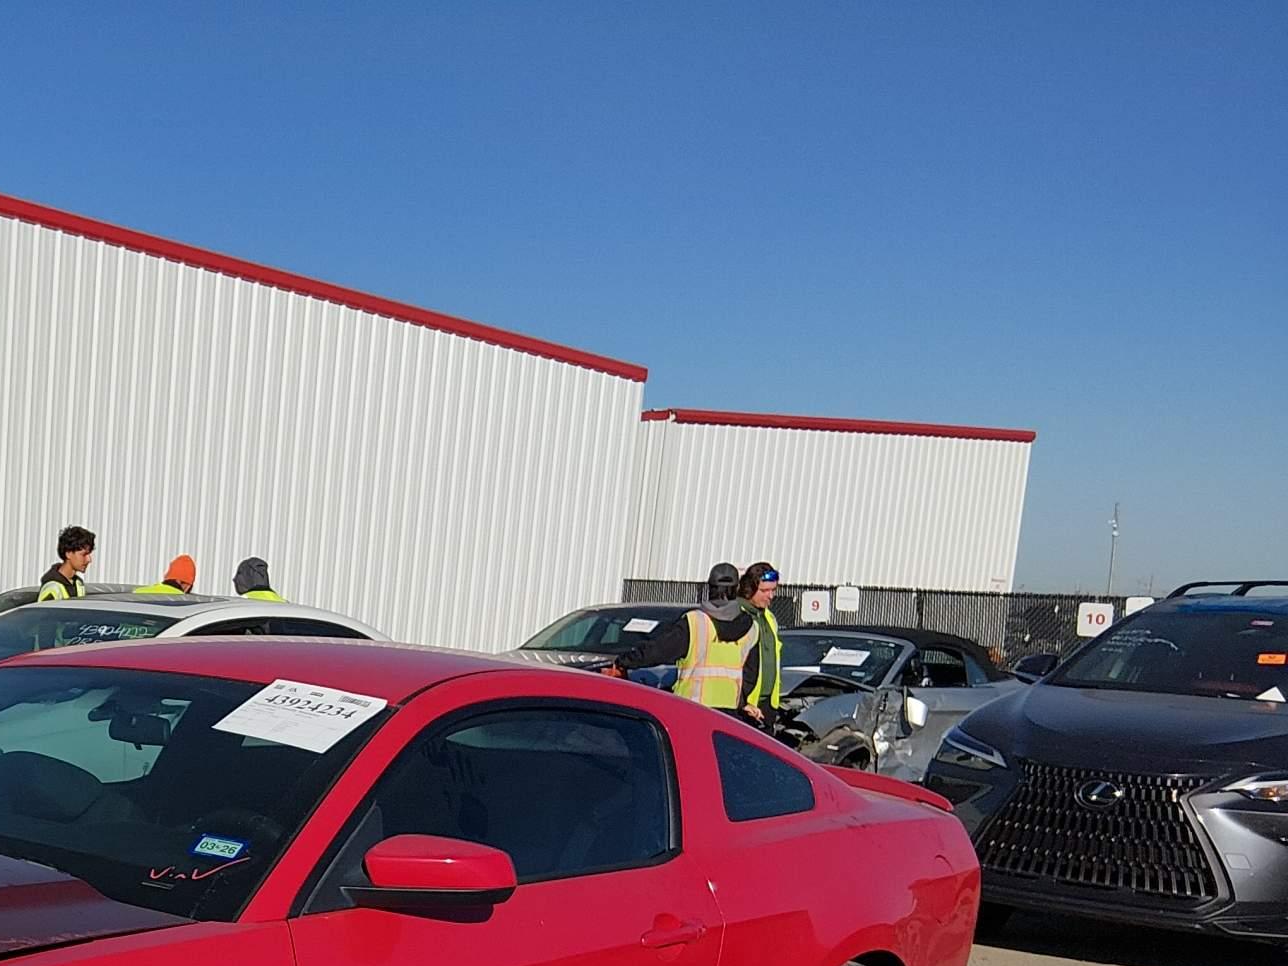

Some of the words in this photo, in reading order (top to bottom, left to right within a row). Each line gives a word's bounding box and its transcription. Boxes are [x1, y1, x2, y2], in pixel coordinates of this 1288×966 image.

[811, 600, 820, 612] 9
[1086, 613, 1106, 625] 10
[265, 694, 357, 719] 43924234
